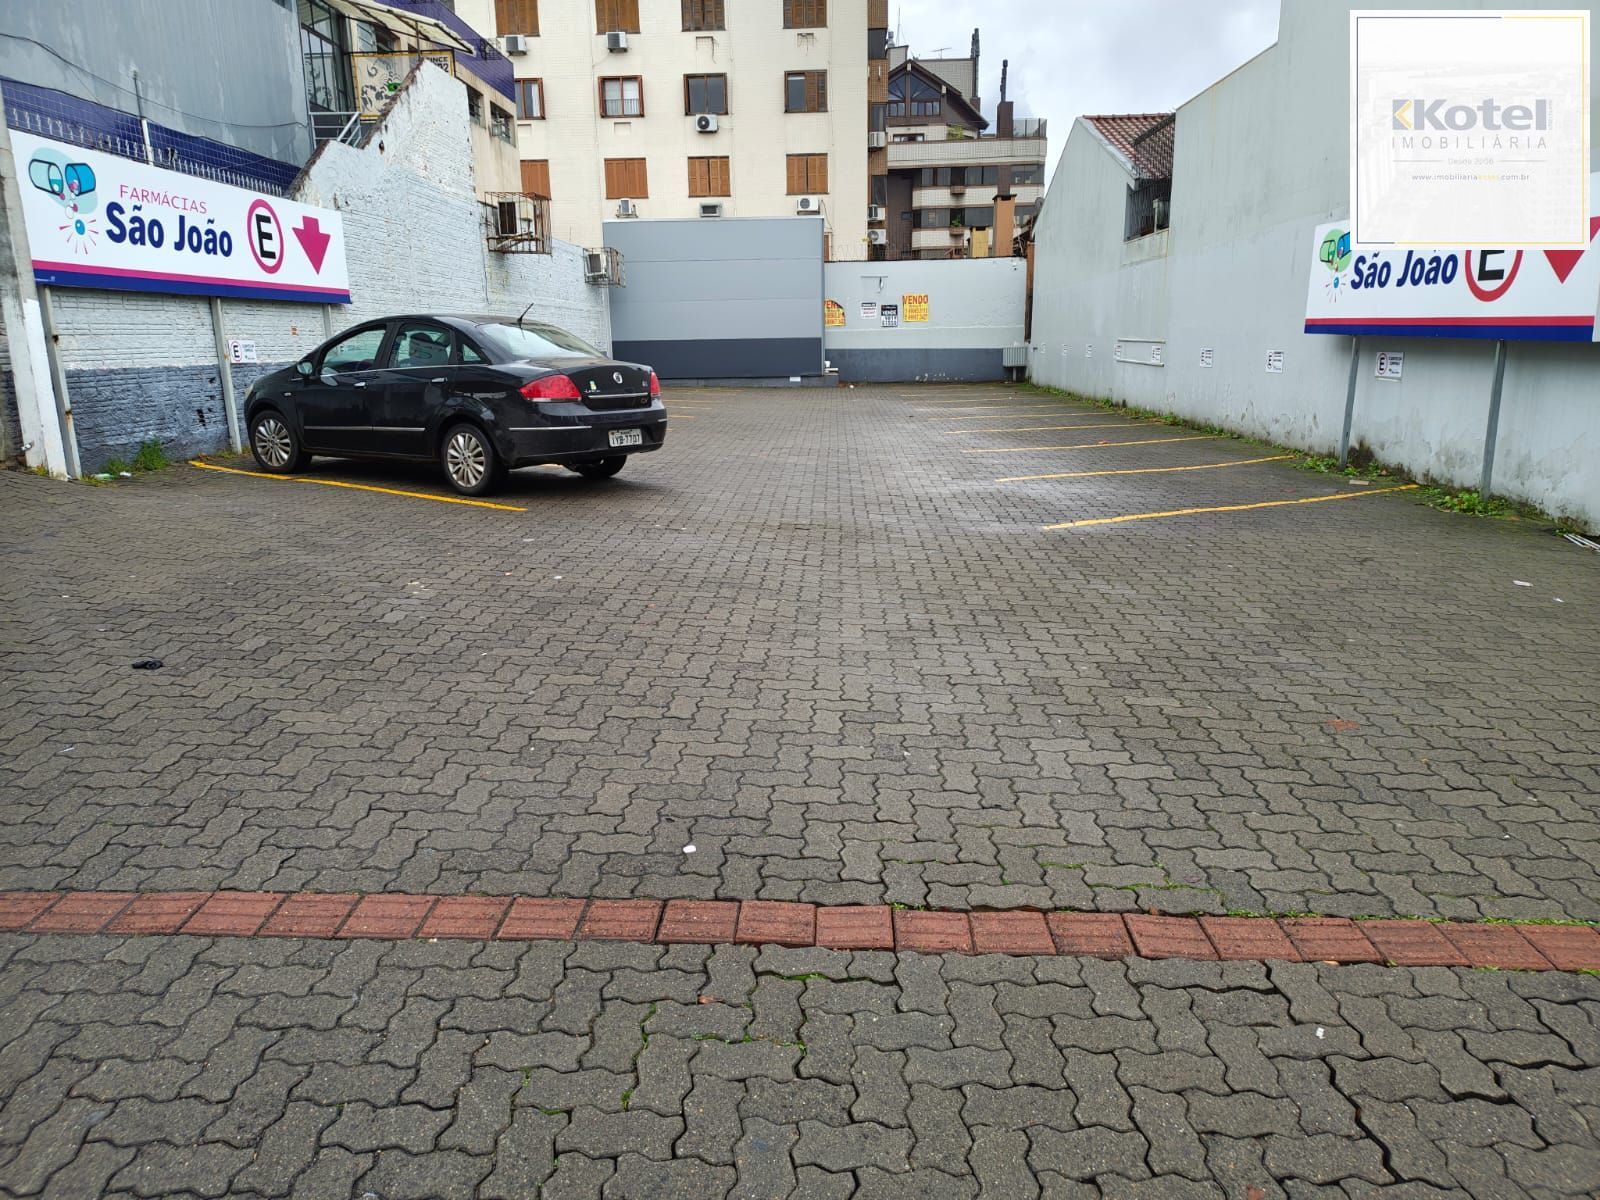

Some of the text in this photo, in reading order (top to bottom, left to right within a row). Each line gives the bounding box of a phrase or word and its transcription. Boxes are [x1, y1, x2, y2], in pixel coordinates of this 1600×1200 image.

[119, 184, 208, 214] FARMÁCIAS
[105, 201, 233, 258] São João
[255, 213, 277, 260] E
[1350, 250, 1459, 290] São João
[902, 295, 929, 304] VENDO
